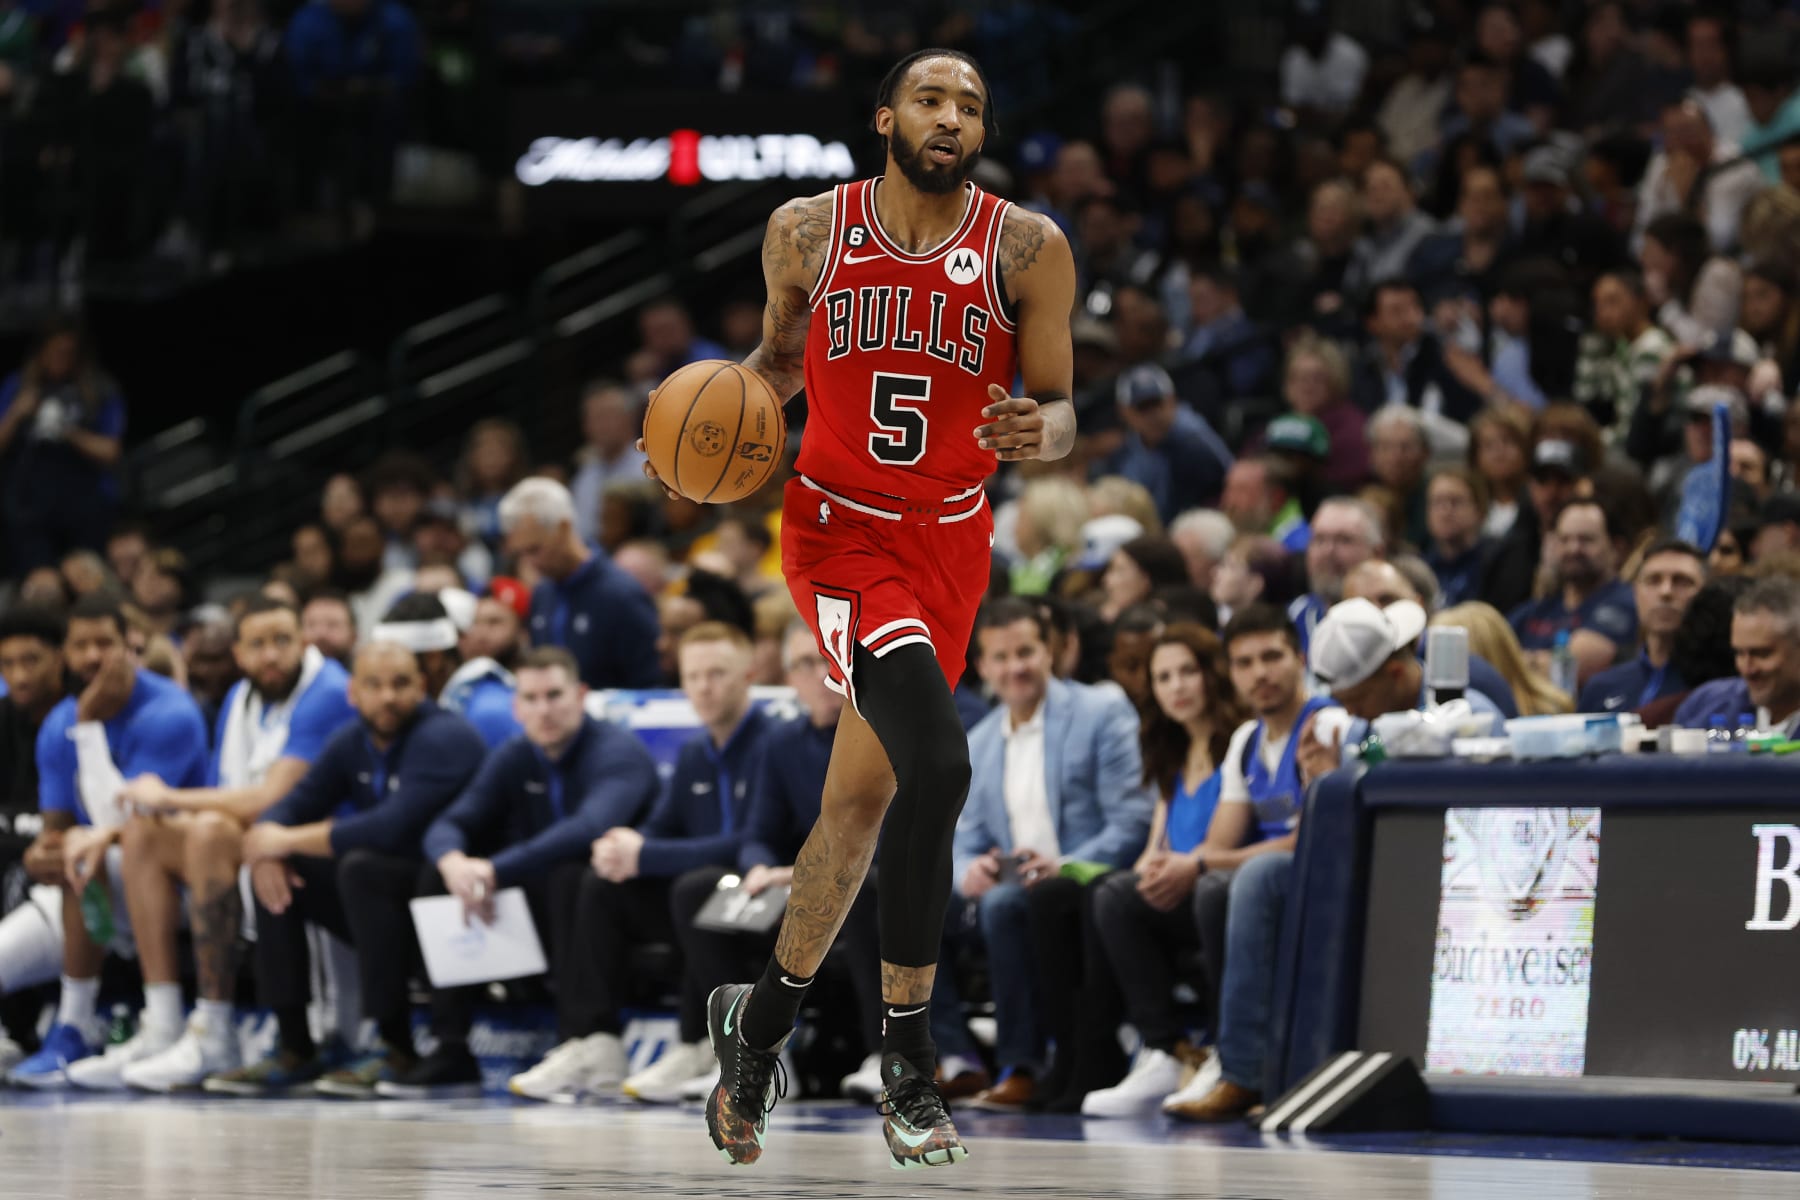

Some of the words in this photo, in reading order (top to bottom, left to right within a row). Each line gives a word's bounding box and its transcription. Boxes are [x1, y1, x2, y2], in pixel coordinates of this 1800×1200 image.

[848, 227, 864, 246] 6
[826, 286, 989, 376] BULLS
[868, 371, 932, 466] 5
[1475, 994, 1546, 1021] ZERO
[1733, 1028, 1769, 1071] 0%
